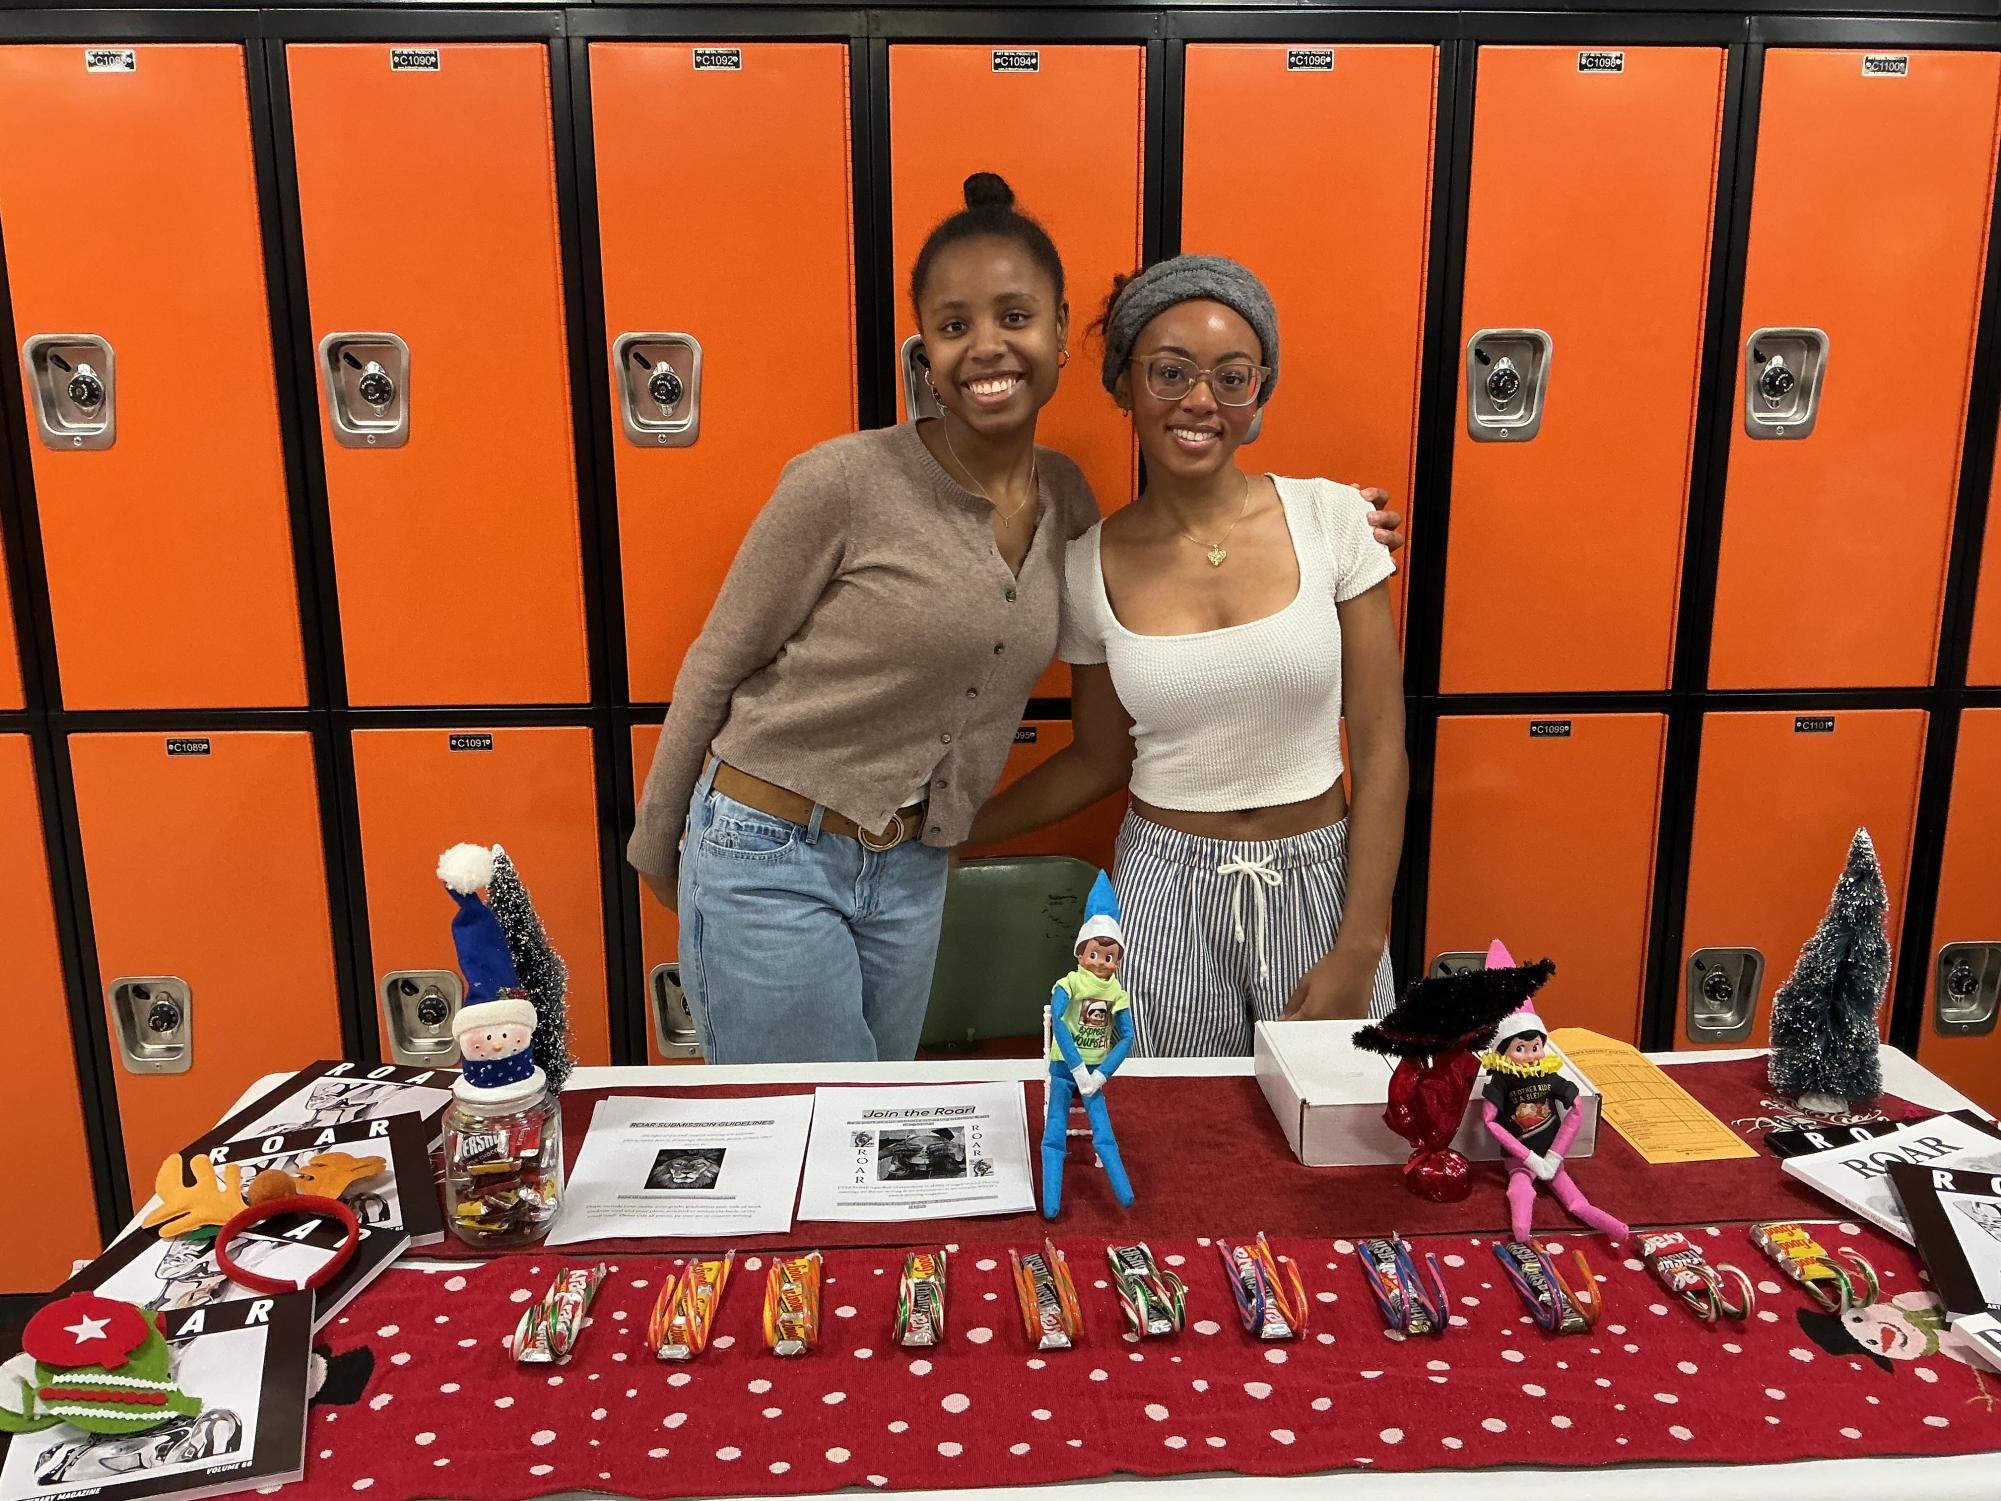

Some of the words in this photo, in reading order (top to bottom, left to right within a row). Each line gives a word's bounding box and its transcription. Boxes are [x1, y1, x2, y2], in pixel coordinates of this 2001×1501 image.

[400, 55, 431, 65] C1090
[702, 55, 734, 65] C1092
[1000, 56, 1031, 67] C1094
[1295, 55, 1326, 65] C1096
[1586, 57, 1617, 68] C1098
[1871, 61, 1900, 71] C1100
[1537, 725, 1565, 734] C1099
[1802, 721, 1829, 730] C1101
[1015, 731, 1030, 740] 095
[174, 743, 204, 752] C1089
[458, 739, 487, 748] C1091
[863, 1109, 899, 1119] Join
[904, 1108, 930, 1117] the
[657, 1121, 717, 1129] SUBMISSION
[718, 1119, 775, 1127] GUIDELINES
[209, 1119, 390, 1164] ROAR
[1838, 1136, 1964, 1180] ROAR
[207, 1462, 240, 1475] VOLUME
[57, 1487, 102, 1500] MAGAZINE
